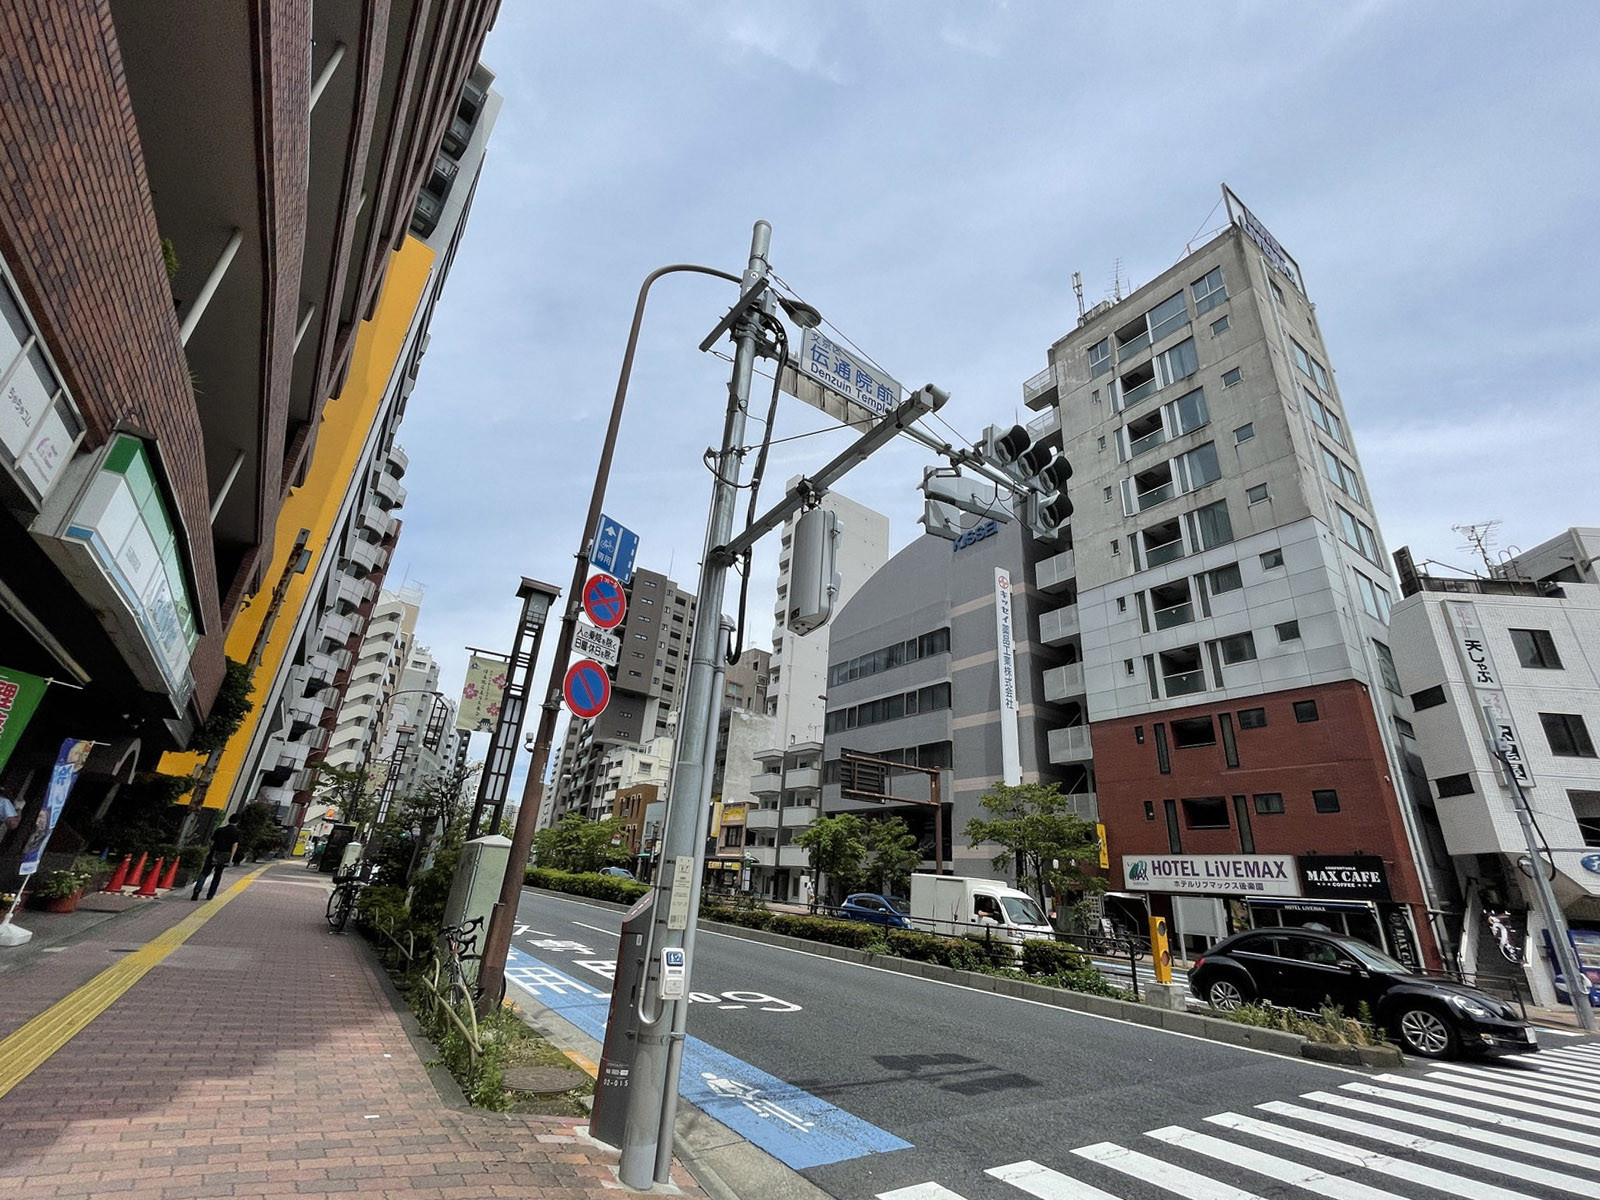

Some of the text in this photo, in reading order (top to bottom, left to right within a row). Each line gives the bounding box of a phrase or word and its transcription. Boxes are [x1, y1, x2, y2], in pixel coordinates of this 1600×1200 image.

[810, 343, 894, 406] 伝通院前
[810, 361, 892, 413] Denzuin Templ
[597, 551, 612, 566] 専用
[1151, 860, 1201, 877] HOTEL
[1306, 870, 1381, 883] MAX CAFE
